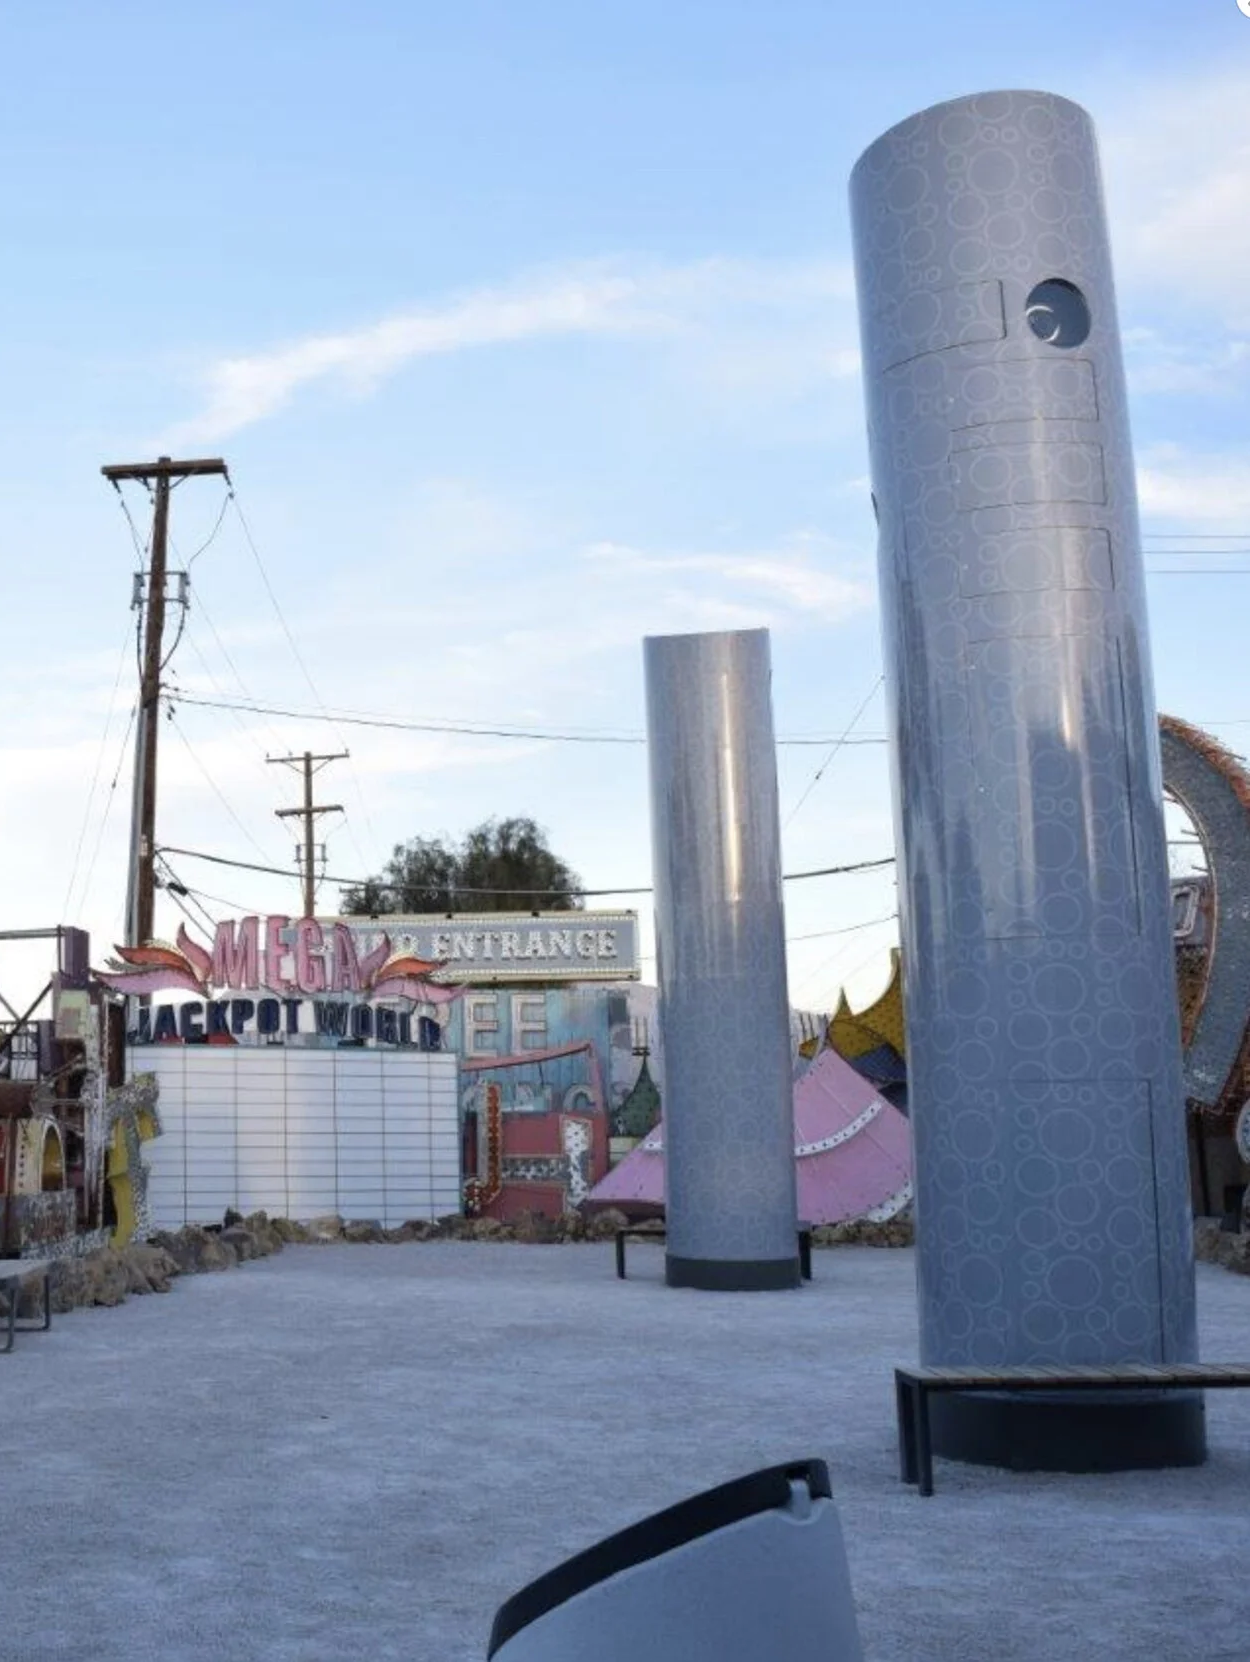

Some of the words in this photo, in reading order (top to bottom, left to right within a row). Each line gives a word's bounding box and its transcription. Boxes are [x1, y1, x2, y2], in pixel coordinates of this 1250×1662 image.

[212, 914, 365, 992] MEGA
[430, 929, 618, 960] ENTRANCE
[127, 998, 303, 1044] JACKPOT
[313, 1001, 443, 1051] WORLD
